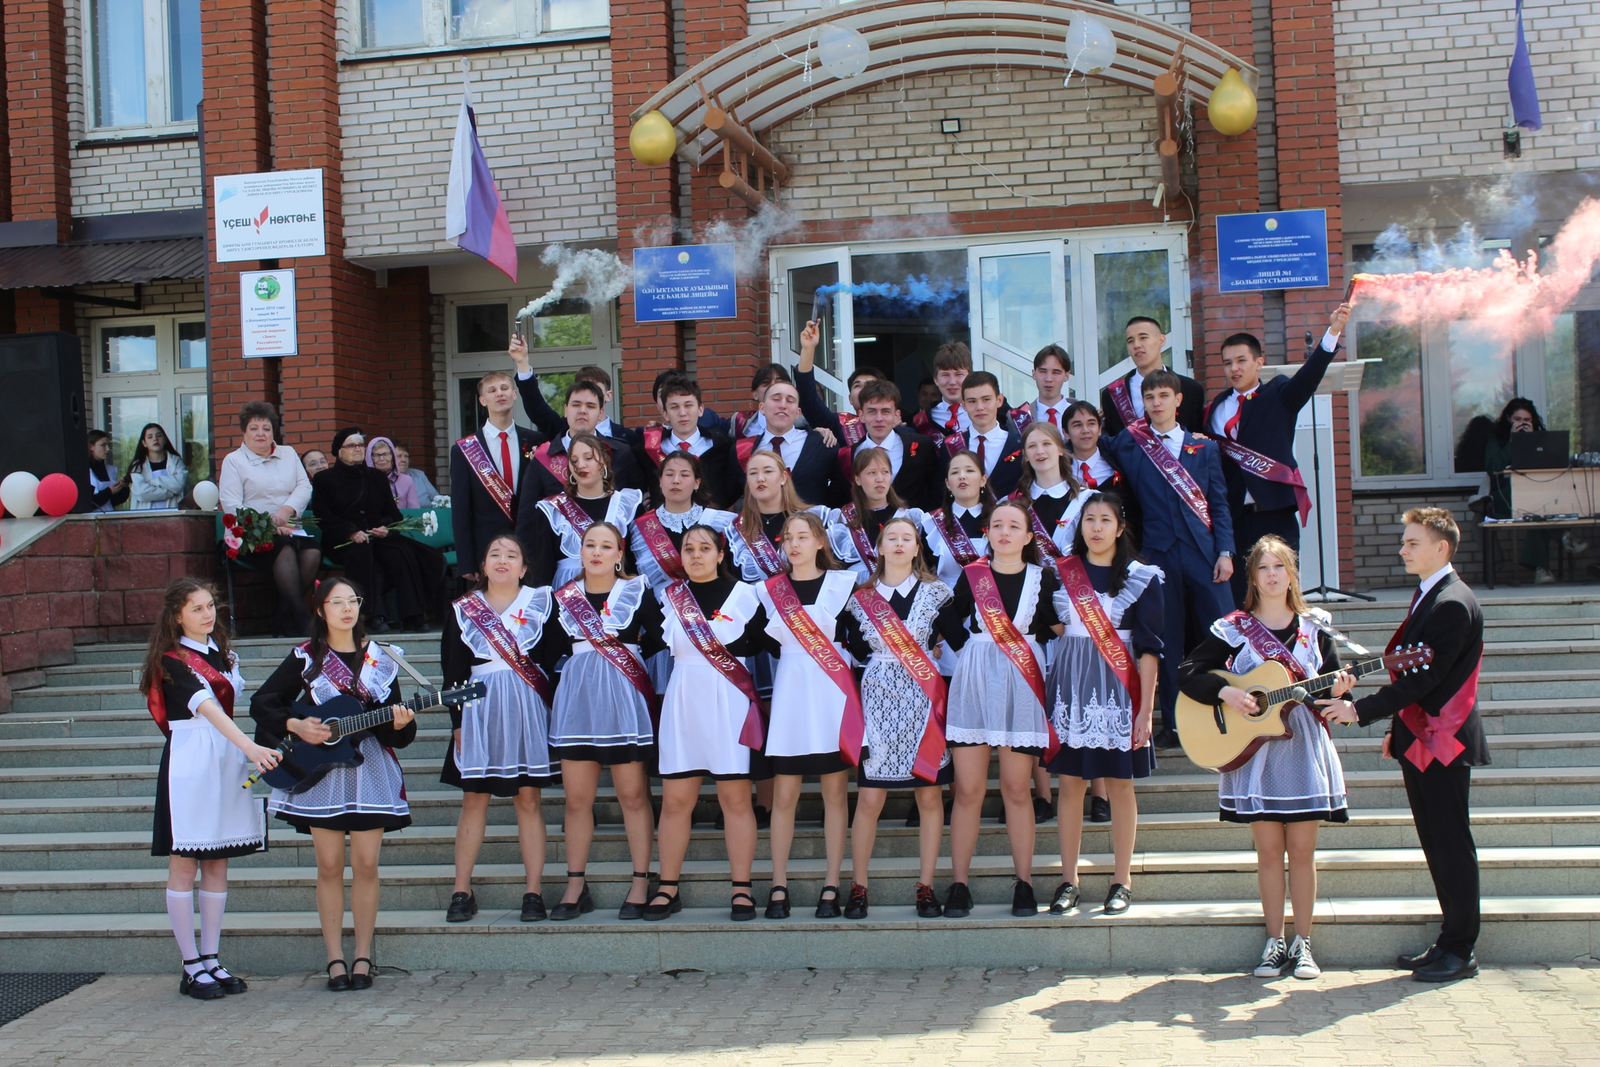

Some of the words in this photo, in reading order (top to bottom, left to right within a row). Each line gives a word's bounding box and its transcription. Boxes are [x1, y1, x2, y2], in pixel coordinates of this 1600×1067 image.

[1257, 270, 1281, 278] ЛИЦЕЙ
[1162, 460, 1195, 499] Выпускник
[1243, 454, 1273, 473] 2025
[780, 595, 822, 651] Выпускница
[817, 648, 844, 670] 2025
[871, 600, 913, 659] Выпускница
[908, 656, 934, 680] 2025
[983, 597, 1023, 656] Выпускница
[1075, 585, 1112, 647] Выпускница
[1106, 646, 1131, 669] 2025
[709, 650, 737, 669] 2025
